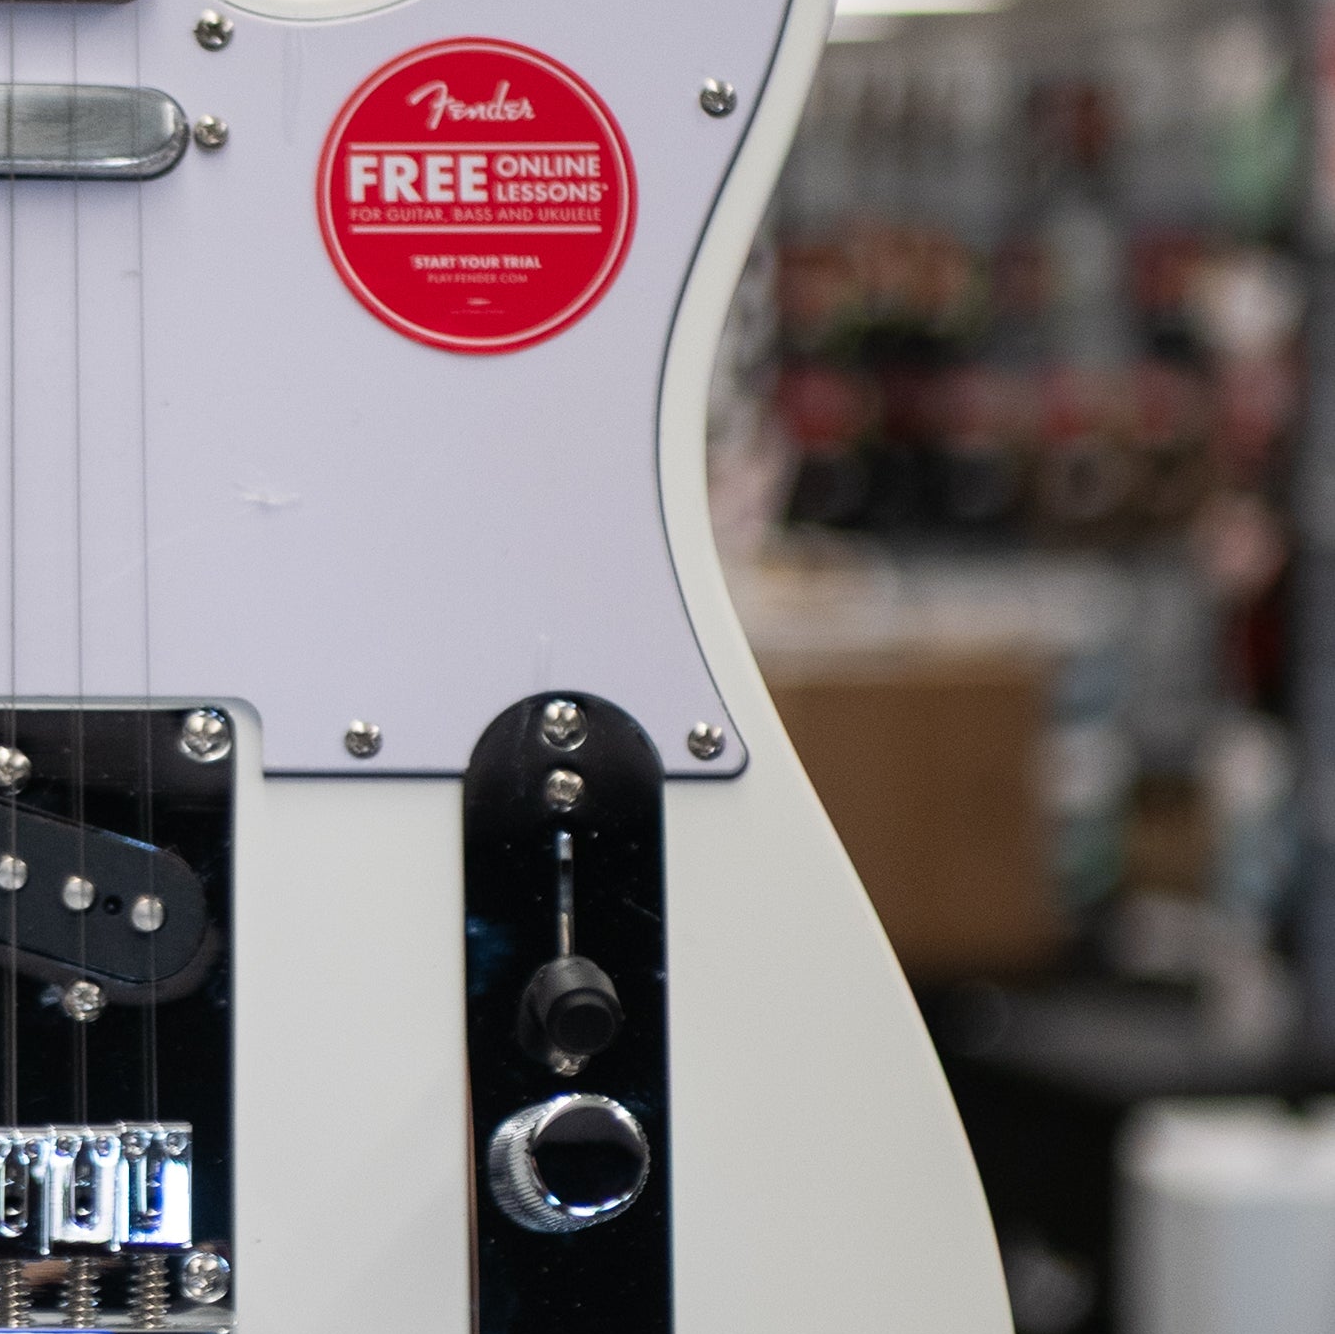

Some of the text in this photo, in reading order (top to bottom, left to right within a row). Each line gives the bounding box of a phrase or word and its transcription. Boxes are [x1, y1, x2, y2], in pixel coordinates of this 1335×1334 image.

[407, 80, 535, 130] Fender
[494, 154, 601, 178] ONLINE
[348, 154, 489, 203] FREE
[350, 207, 602, 223] FOR GUITAR, BASS AND UKULELE
[412, 254, 542, 269] START YOUR TRIAL
